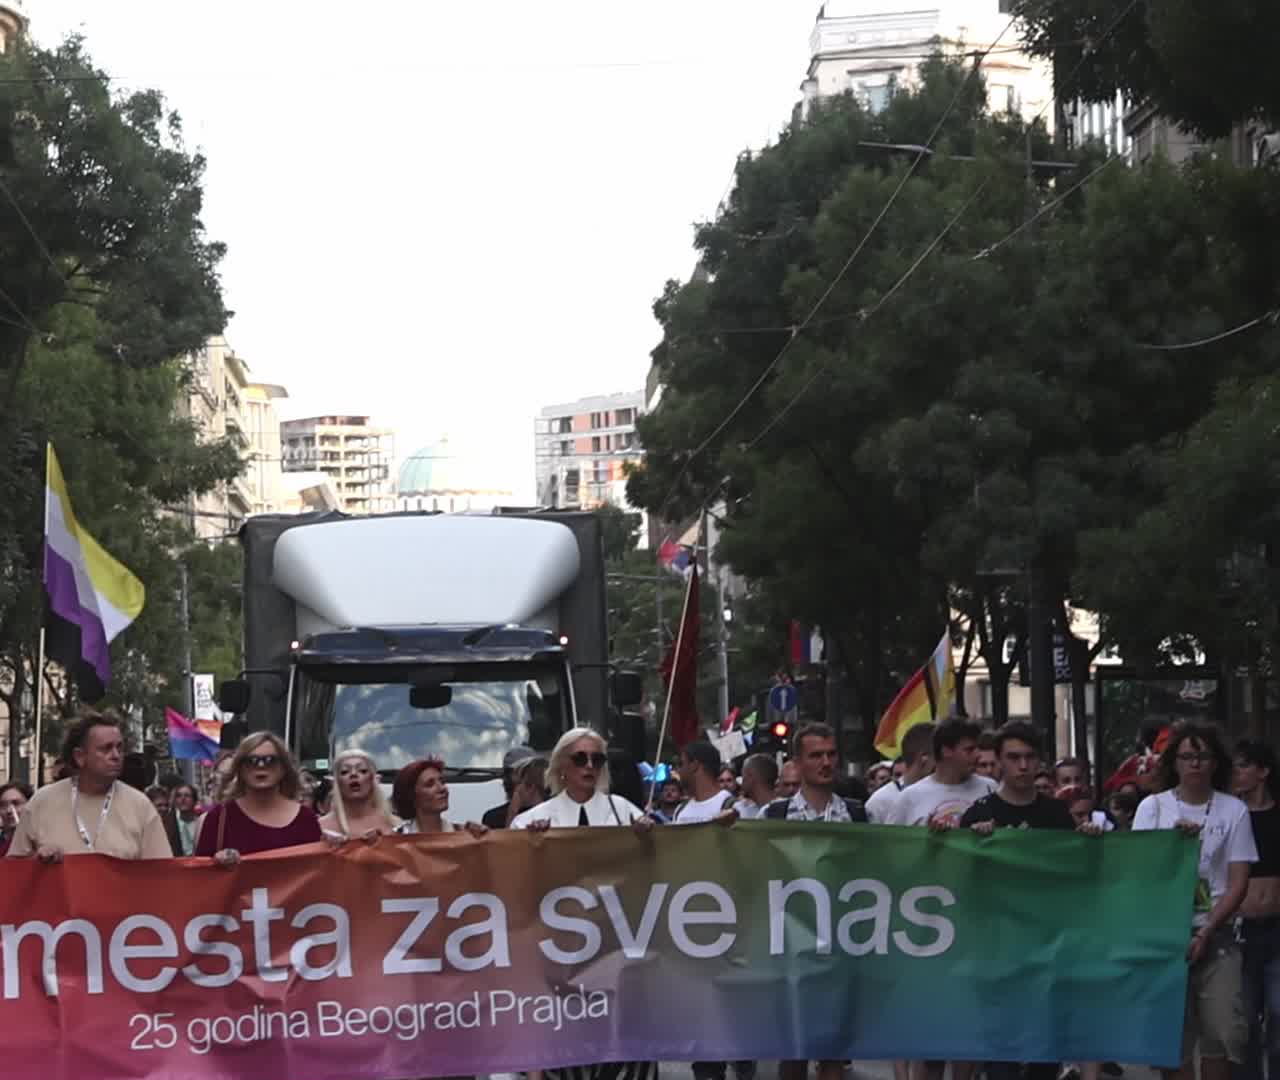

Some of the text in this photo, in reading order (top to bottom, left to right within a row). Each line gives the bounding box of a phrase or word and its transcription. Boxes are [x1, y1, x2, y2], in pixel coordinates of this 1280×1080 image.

[0, 887, 353, 999] mesta
[380, 891, 512, 975] za
[538, 880, 737, 965] sve
[767, 877, 956, 957] nas
[129, 985, 609, 1054] 25 godina Beograd Prajda
